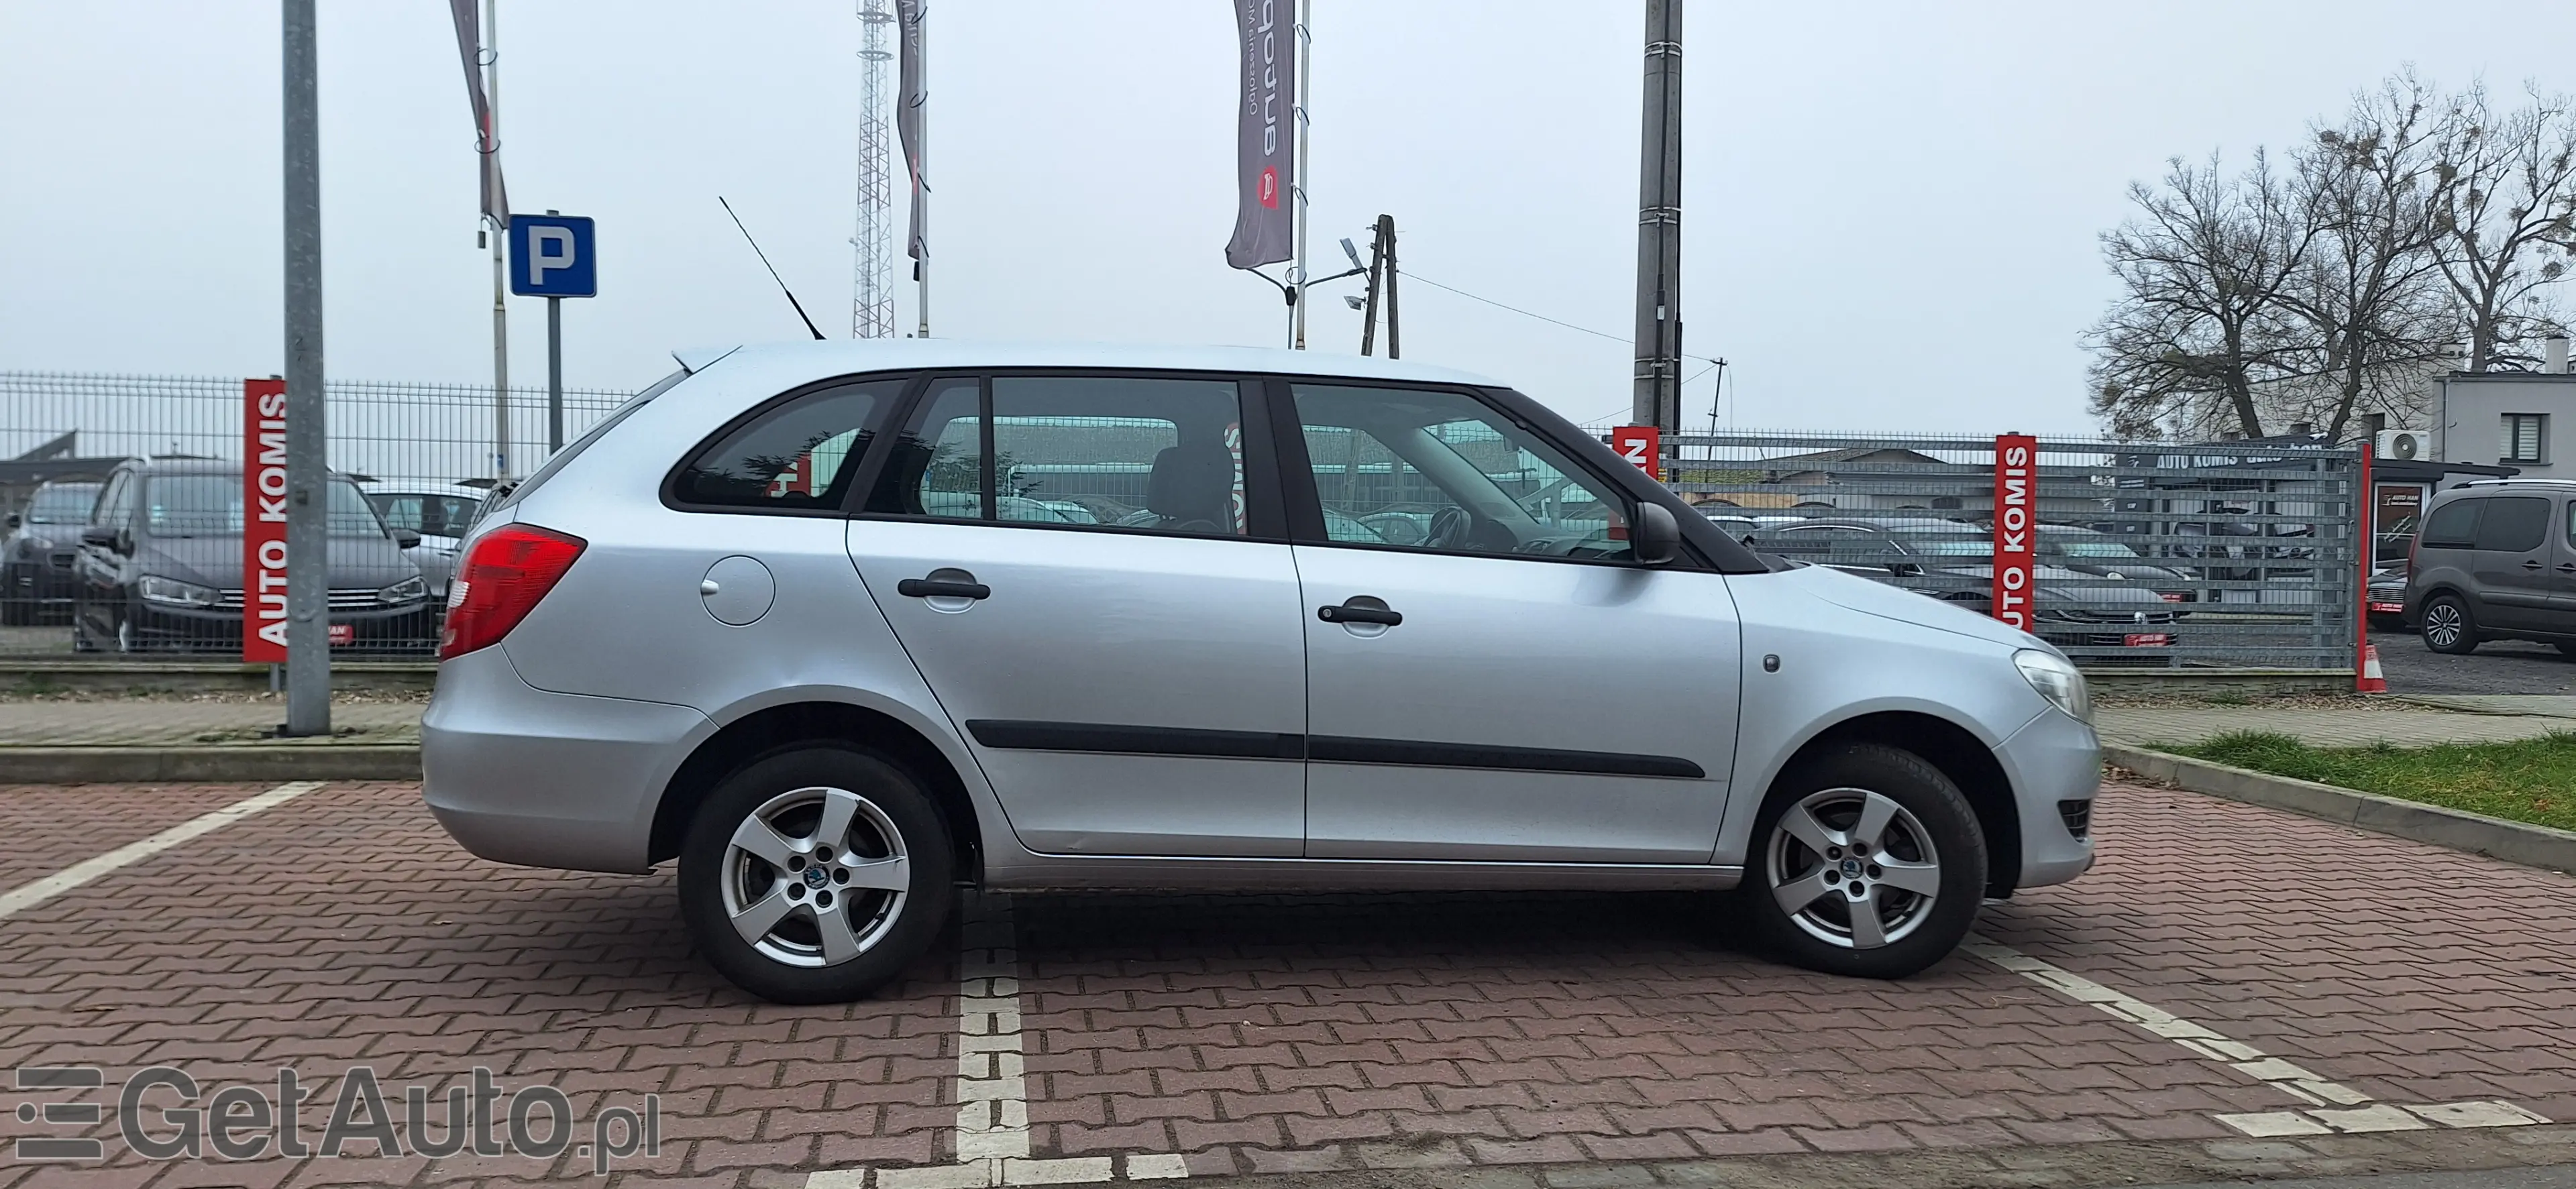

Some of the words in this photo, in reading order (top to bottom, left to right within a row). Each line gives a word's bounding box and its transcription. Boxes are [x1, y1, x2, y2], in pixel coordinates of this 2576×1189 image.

[528, 225, 575, 286] P
[259, 393, 287, 522] KOMIS
[2003, 447, 2027, 553] KOMIS
[259, 540, 287, 647] AUTO
